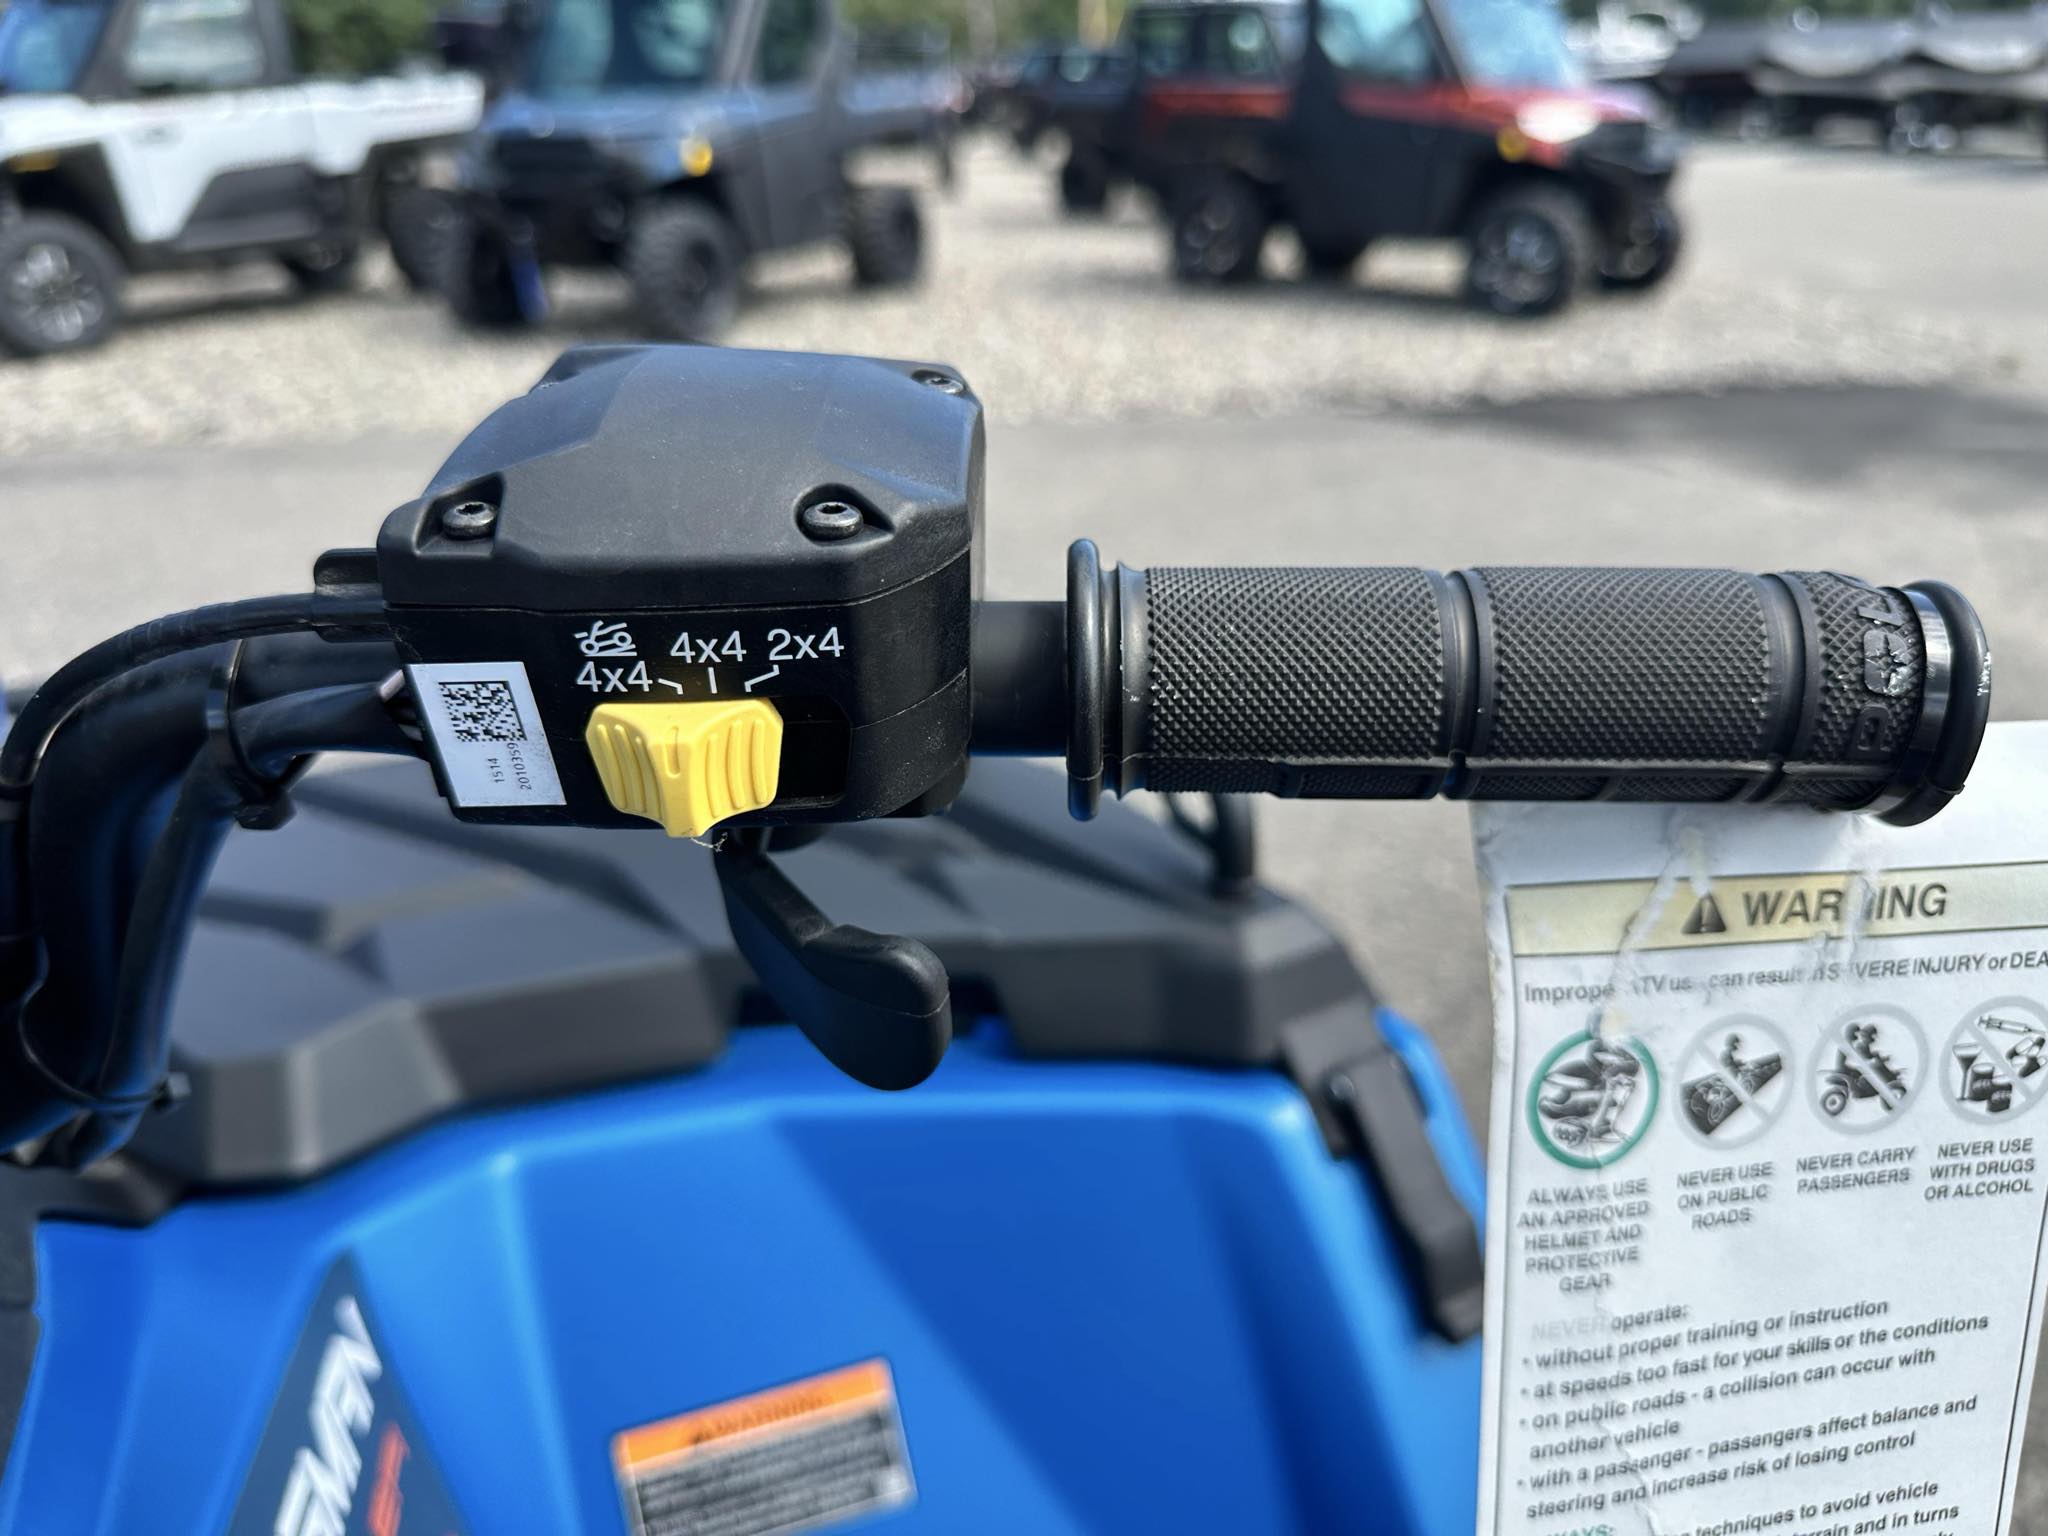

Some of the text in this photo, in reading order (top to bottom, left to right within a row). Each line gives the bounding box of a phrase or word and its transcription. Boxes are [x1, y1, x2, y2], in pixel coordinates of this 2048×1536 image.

[670, 626, 845, 664] 4x4 2x4
[576, 661, 653, 693] 4x4
[487, 758, 505, 783] 1514
[507, 742, 532, 790] 2010359
[1742, 882, 1948, 928] WARING
[1524, 982, 1616, 1005] Imprope
[1709, 971, 1745, 989] can
[1827, 958, 1909, 981] SVERE
[1913, 953, 1986, 975] INJURY
[1988, 955, 2008, 970] or
[1796, 1145, 1917, 1173] NEVER CARRY
[1937, 1137, 2034, 1159] NEVER USE
[1677, 1161, 1773, 1188] NEVER USE
[1797, 1167, 1911, 1194] PASSENGERS
[1930, 1158, 2035, 1179] WITH DRUGS
[1528, 1178, 1648, 1205] ALWAYS USE
[1678, 1184, 1770, 1211] ON PUBLIC
[1924, 1179, 2034, 1200] OR ALCOHOL
[1518, 1200, 1650, 1228] AN APPROVED
[1692, 1207, 1754, 1230] ROADS
[1524, 1224, 1641, 1250] HELMET AND
[1525, 1246, 1640, 1273] PROTECTIVE
[1559, 1273, 1611, 1293] GEAR
[1612, 1304, 1689, 1333] operate:
[1535, 1300, 1888, 1368] without proper training or instruction
[1533, 1314, 1989, 1398] at speeds too fast for your skills or the conditions
[1532, 1413, 1559, 1429] on
[1565, 1400, 1627, 1428] public
[1632, 1388, 1686, 1413] roads
[1703, 1385, 1714, 1399] a
[1719, 1371, 1797, 1396] collision
[1803, 1364, 1836, 1382] can
[1841, 1354, 1893, 1375] occur
[1898, 1347, 1936, 1368] with
[1529, 1468, 1571, 1490] with
[1577, 1466, 1588, 1480] a
[1593, 1446, 1692, 1482] passenger
[1708, 1426, 1813, 1458] passengers
[1817, 1413, 1868, 1435] affect
[1872, 1401, 1939, 1426] balance
[1944, 1395, 1978, 1415] and
[1530, 1419, 1680, 1460] another vehicle
[1527, 1430, 1916, 1519] steering and increase risk of losing control
[1800, 1502, 1817, 1520] to
[1822, 1491, 1871, 1515] avoid
[1875, 1481, 1939, 1506] vehicle
[1854, 1515, 1887, 1535] and
[1892, 1512, 1908, 1528] in
[1913, 1504, 1960, 1524] turns
